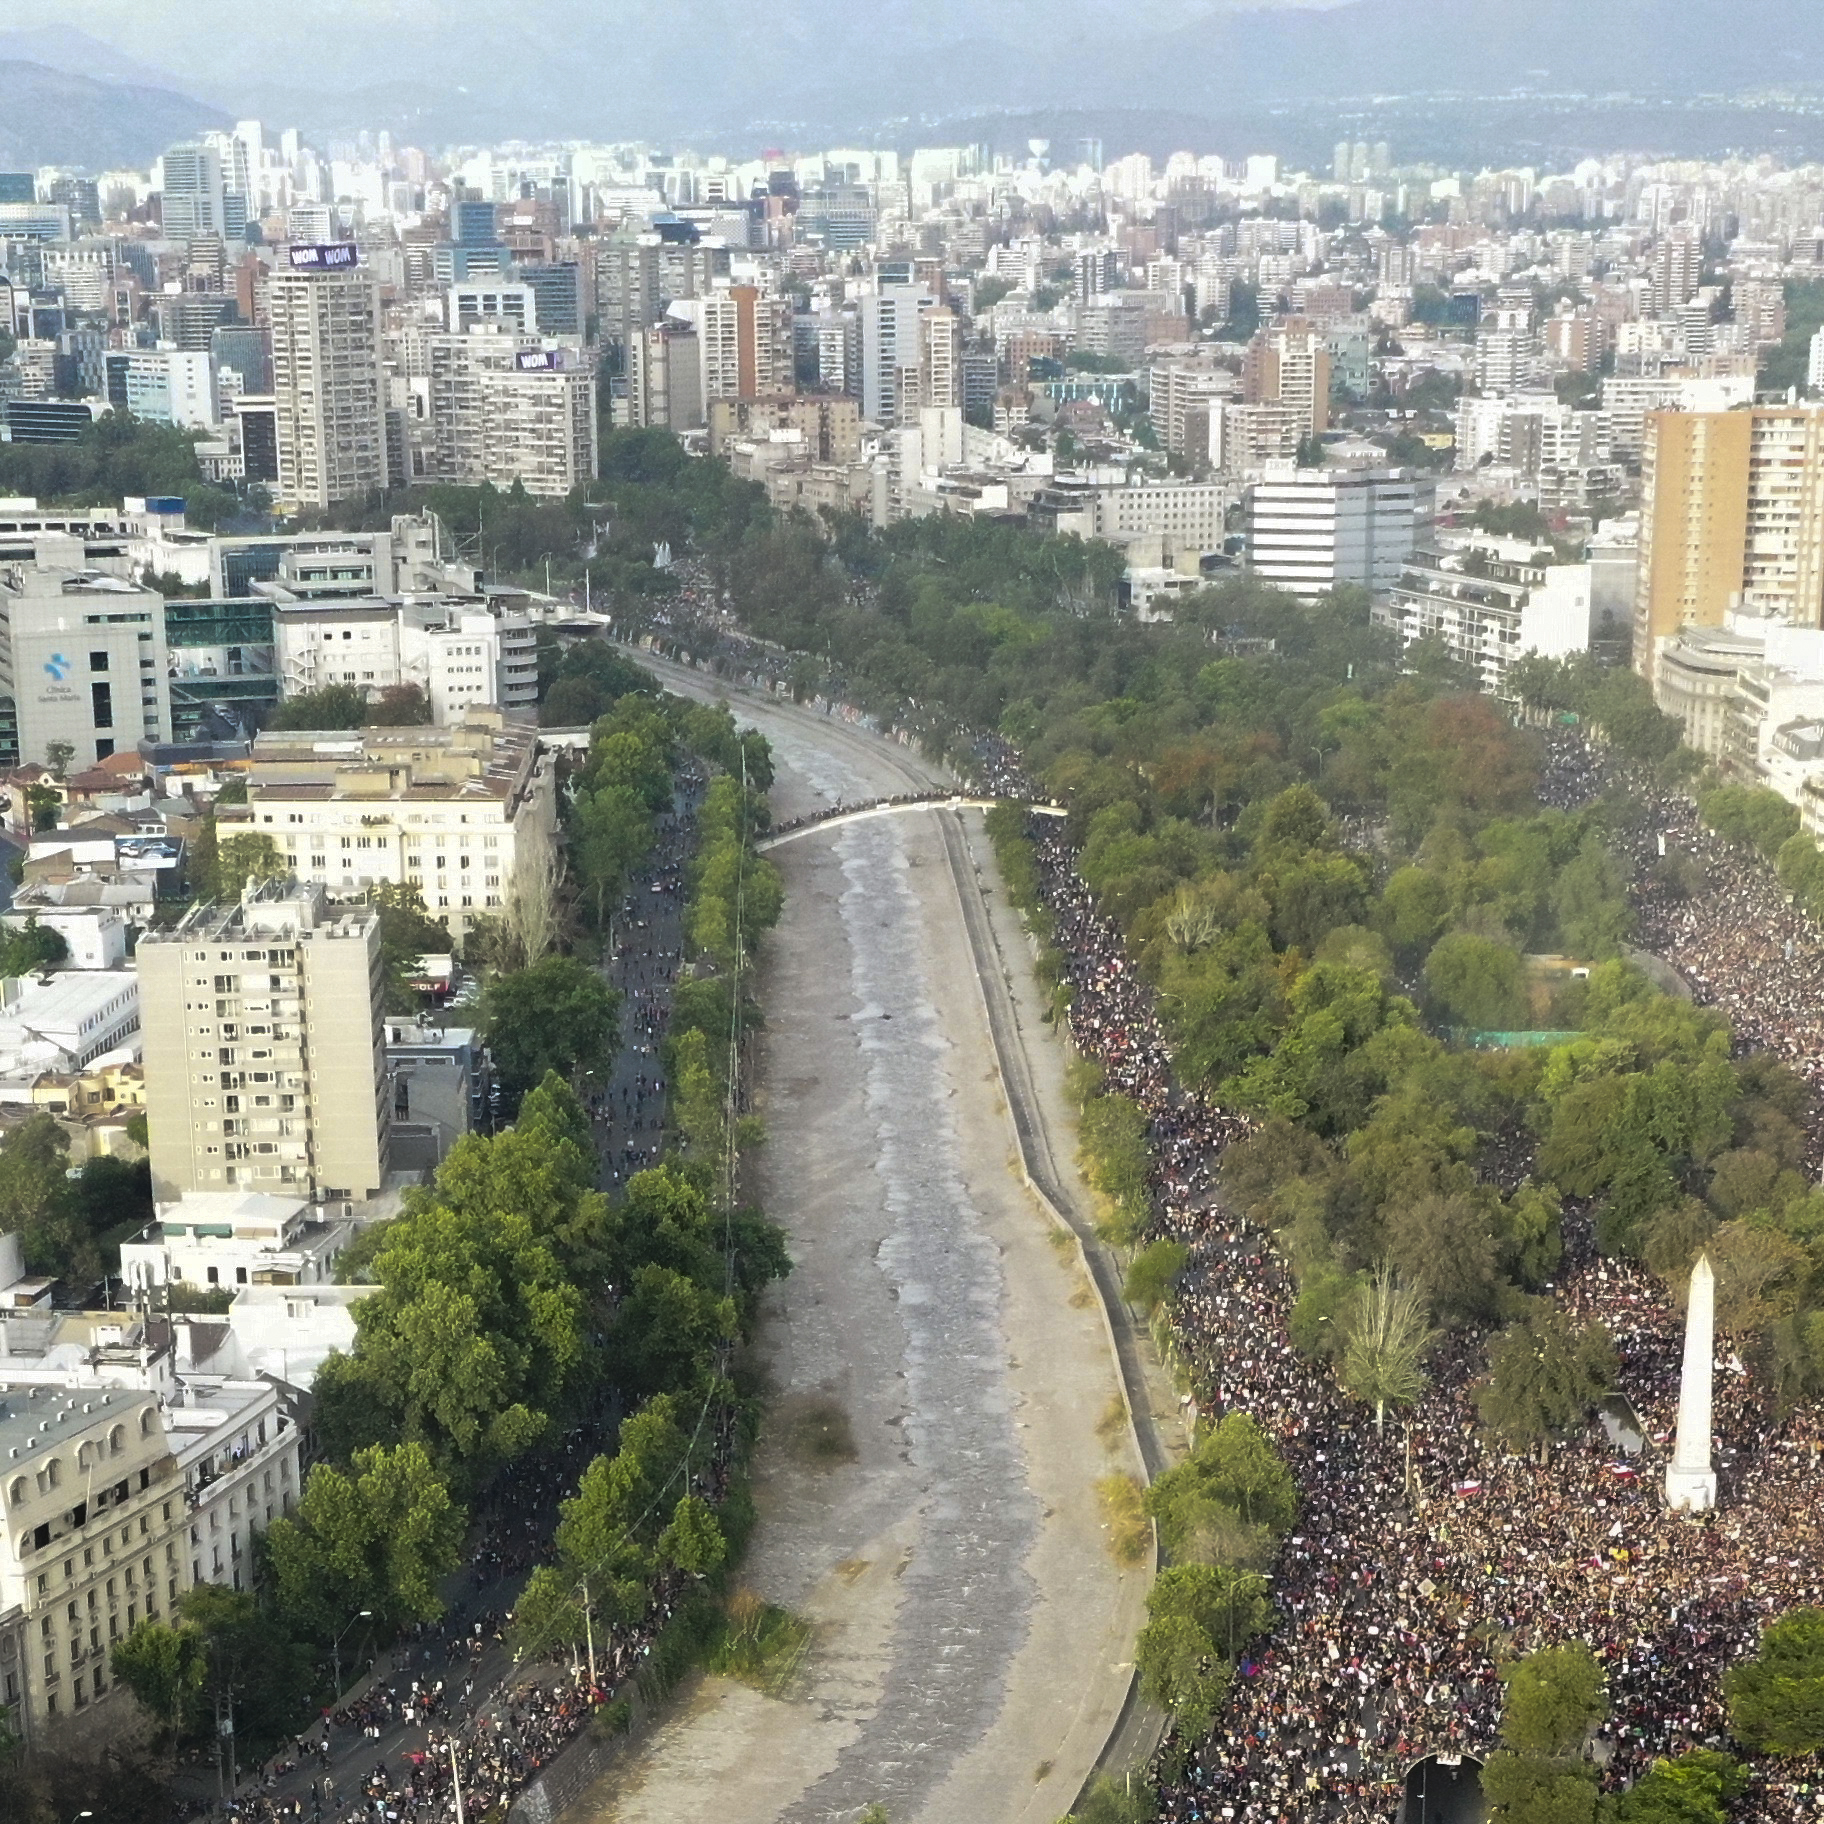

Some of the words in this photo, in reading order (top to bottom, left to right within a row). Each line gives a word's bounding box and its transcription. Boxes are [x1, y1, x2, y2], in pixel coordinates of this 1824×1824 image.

[291, 248, 319, 265] WOM
[325, 246, 351, 265] WOM
[520, 353, 548, 368] WOM
